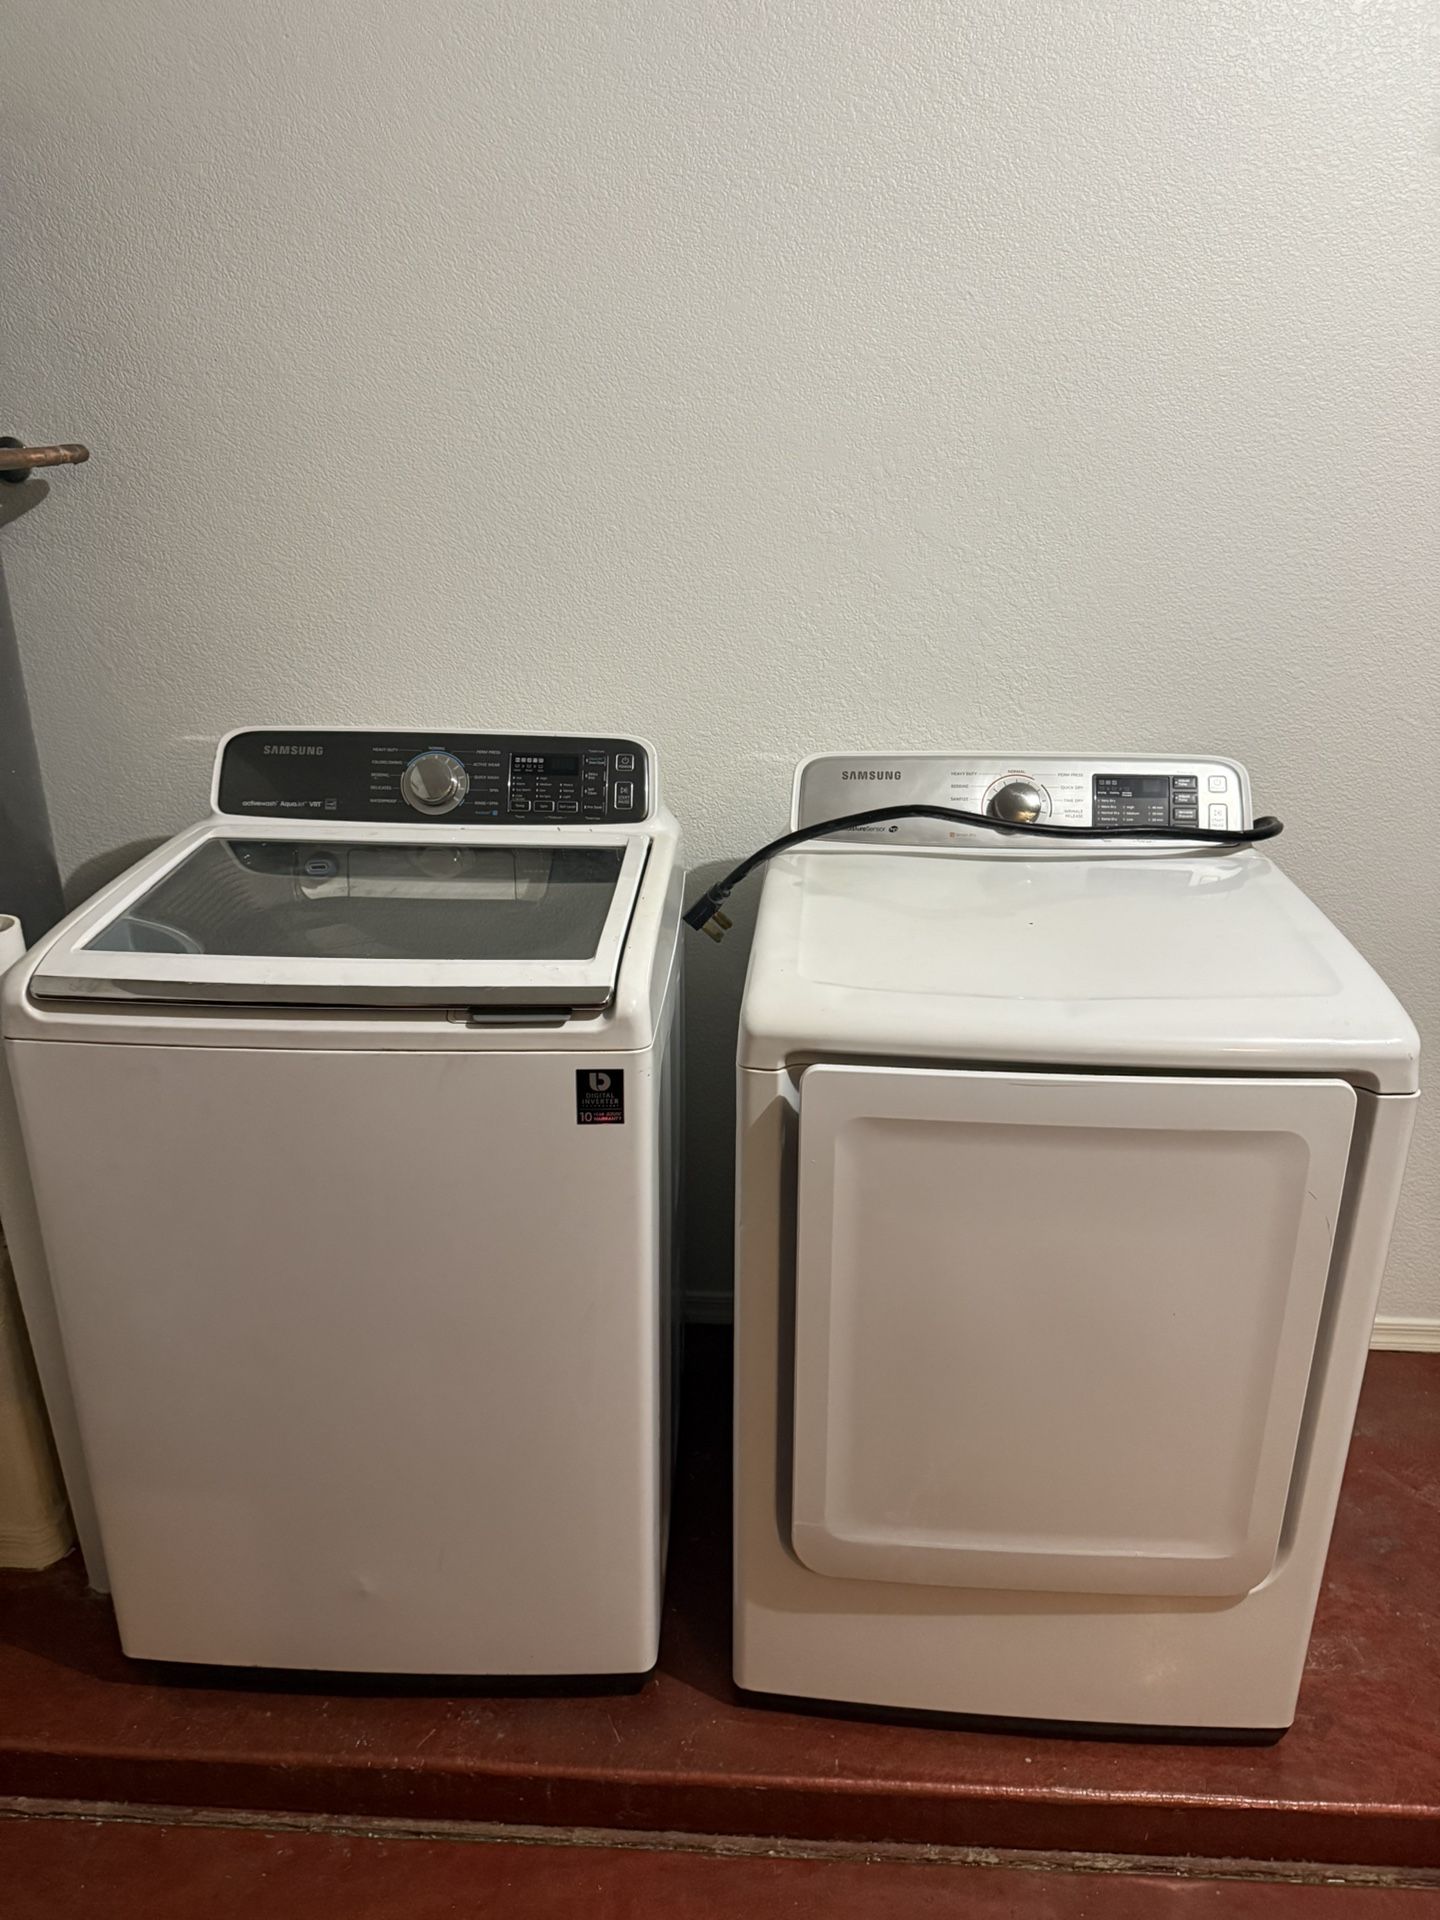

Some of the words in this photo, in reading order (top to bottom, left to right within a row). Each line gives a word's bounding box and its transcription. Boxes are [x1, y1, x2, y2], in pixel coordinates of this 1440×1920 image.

[263, 745, 324, 756] SAMSUNG
[841, 771, 902, 781] SAMSUNG
[579, 1111, 593, 1122] 10
